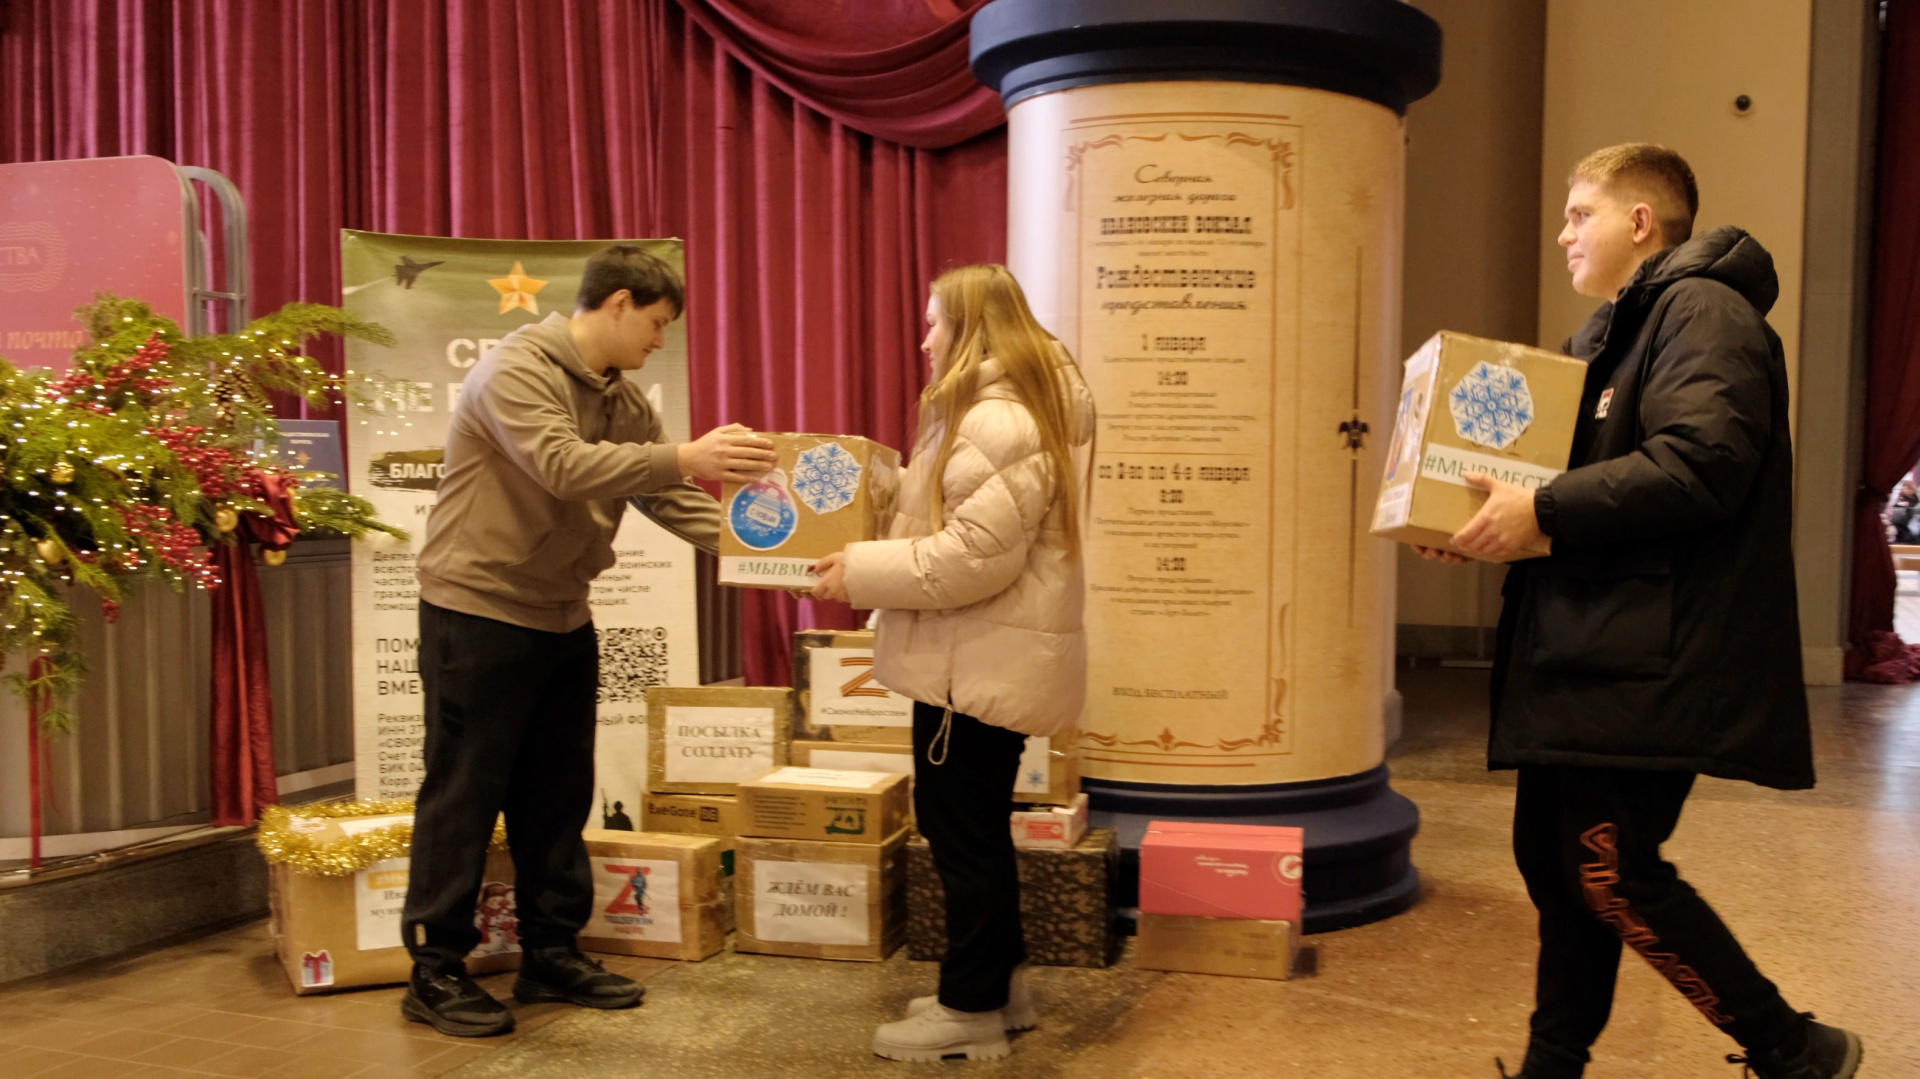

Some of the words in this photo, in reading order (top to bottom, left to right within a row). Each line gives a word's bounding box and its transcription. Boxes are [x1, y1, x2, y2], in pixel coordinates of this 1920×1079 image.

[0, 246, 40, 265] ТВА
[375, 382, 434, 413] НЕ
[1424, 454, 1554, 489] #МЫМЕСТ
[678, 725, 761, 738] ПОСЫЛКА
[681, 745, 754, 759] СОЛДАТУ
[821, 883, 856, 898] ВАС
[773, 902, 838, 918] ДОМОЙ
